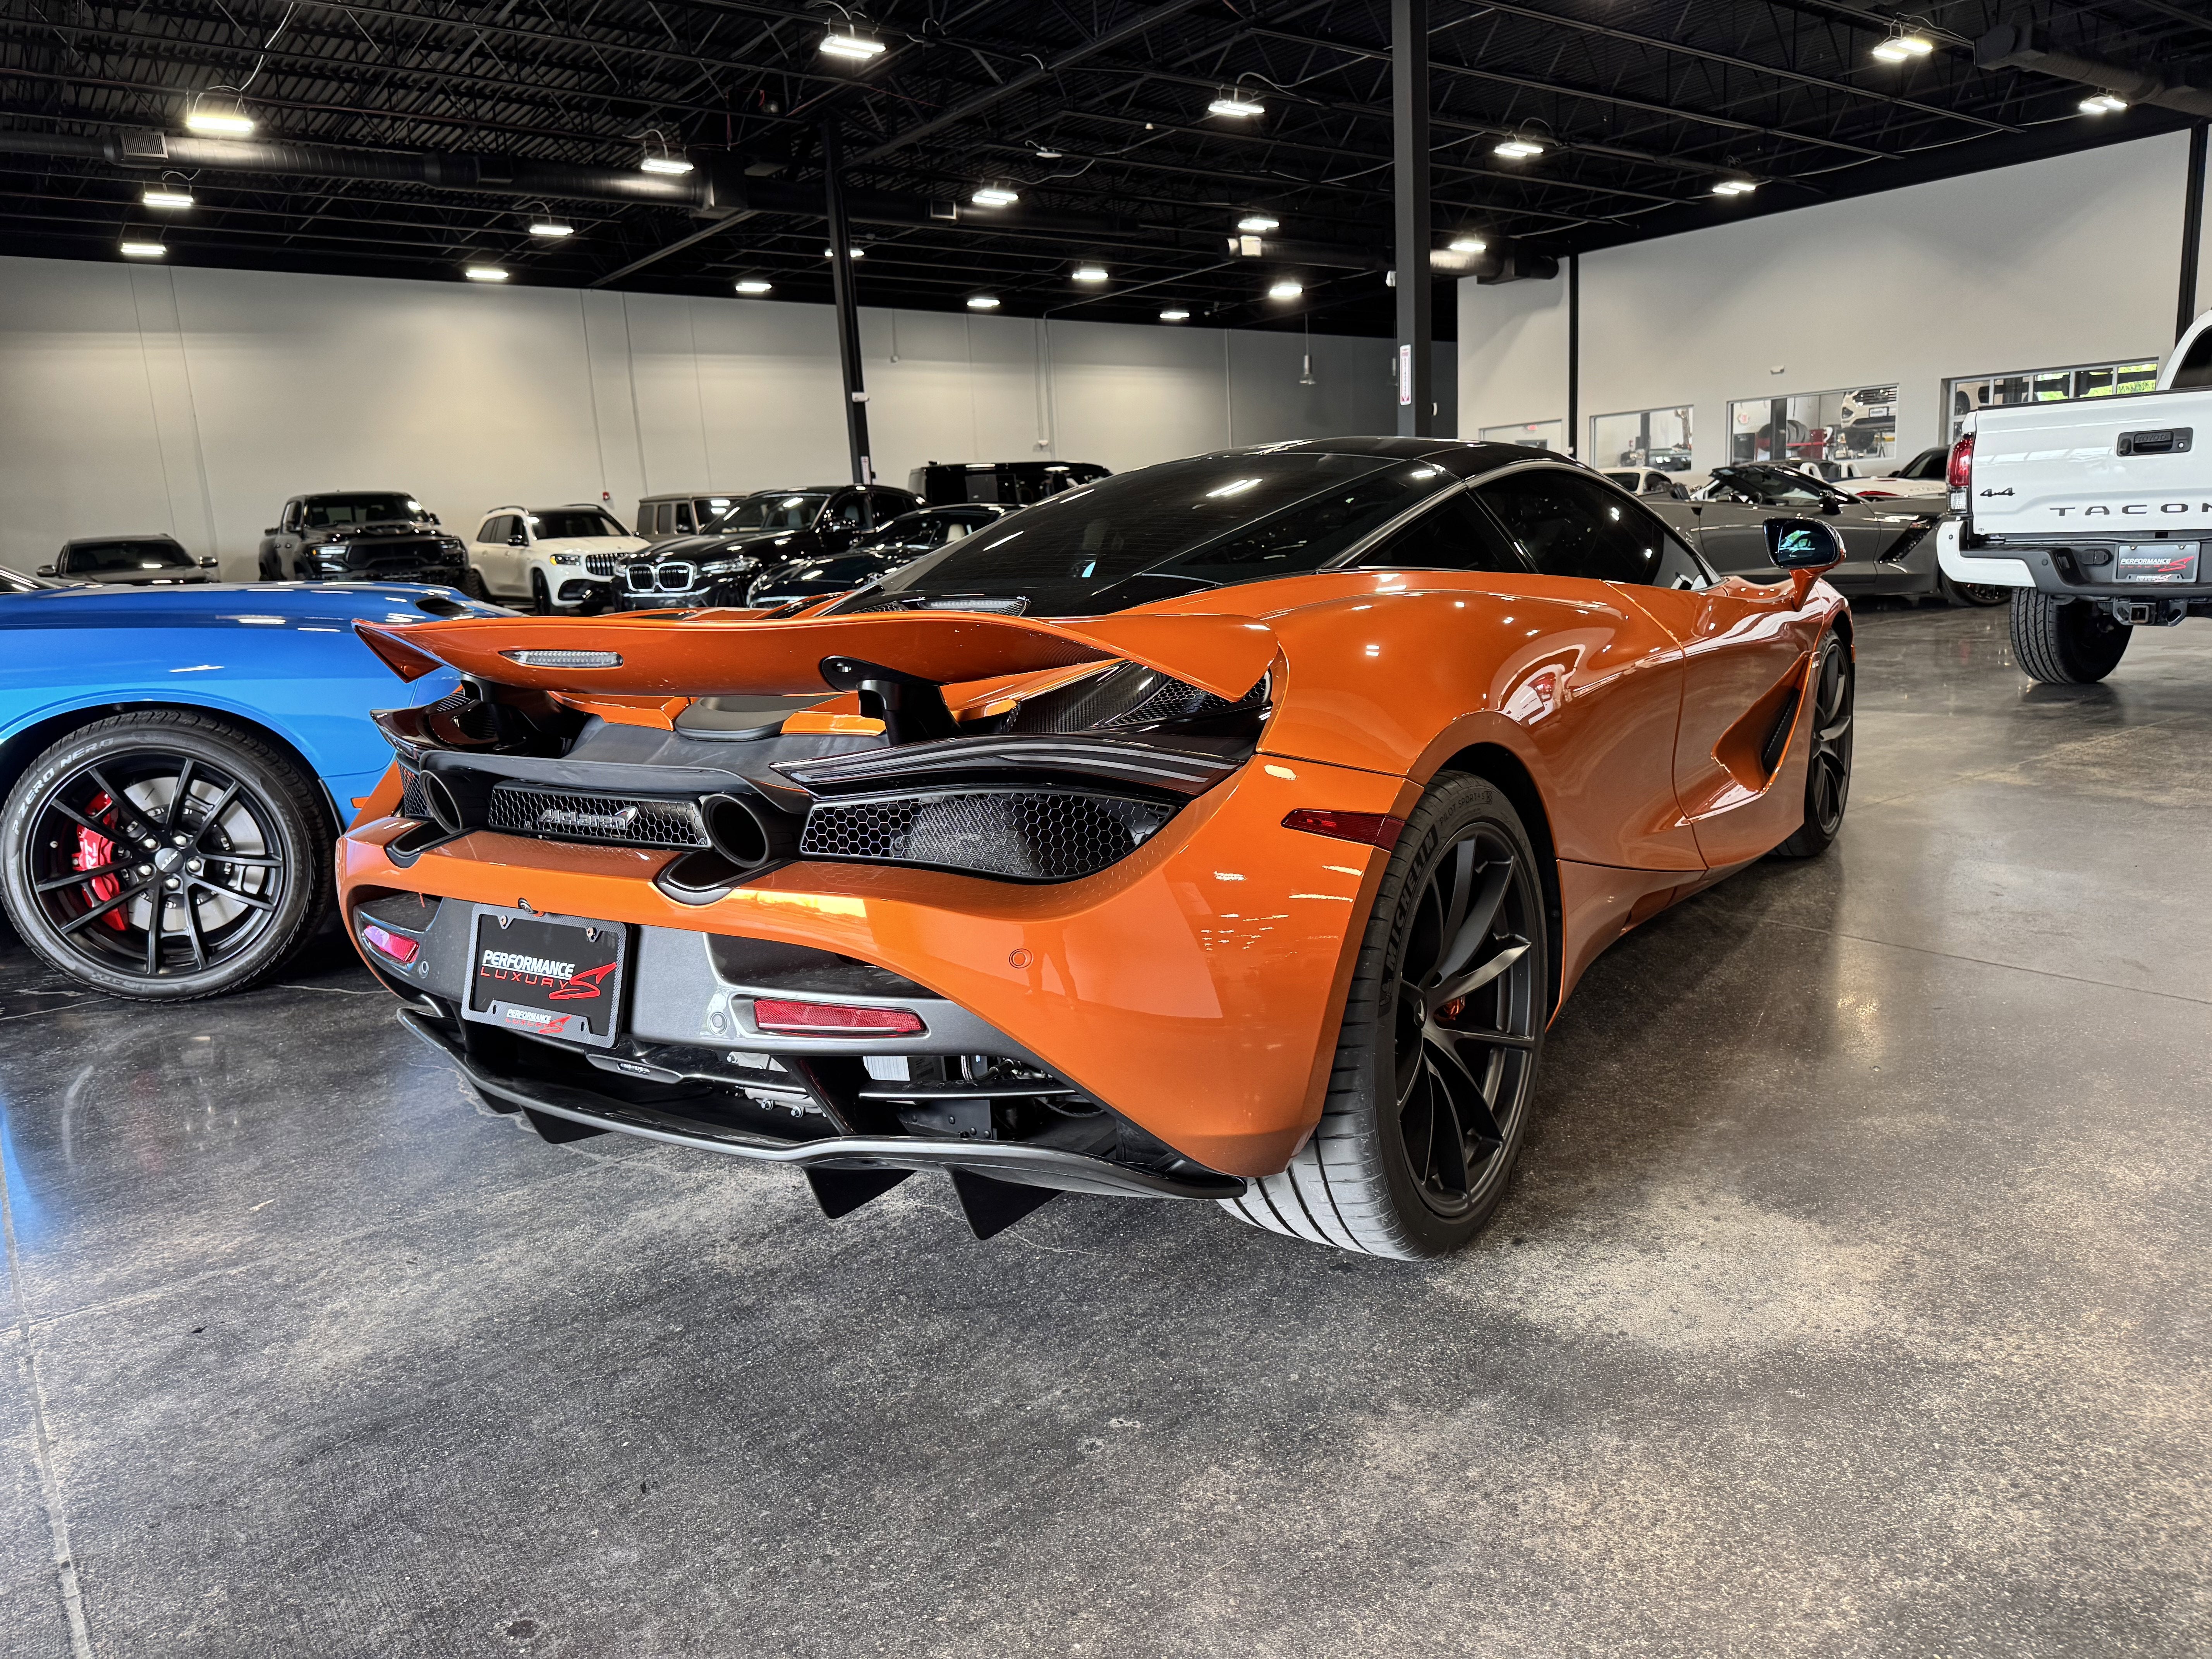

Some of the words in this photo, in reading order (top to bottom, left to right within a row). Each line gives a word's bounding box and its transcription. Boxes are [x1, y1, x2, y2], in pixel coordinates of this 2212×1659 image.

[12, 819, 19, 835] P
[18, 768, 55, 818] ZERO
[60, 738, 113, 768] NERO
[538, 809, 627, 829] McLaren
[1440, 804, 1455, 826] PILOT
[1458, 793, 1477, 808] SPORT
[1386, 831, 1437, 971] MICHELIN
[483, 950, 575, 979] PERFORMANCE
[480, 967, 570, 989] LUXURY
[505, 1017, 549, 1029] LUXURY
[507, 1008, 552, 1023] PERFORMANCE
